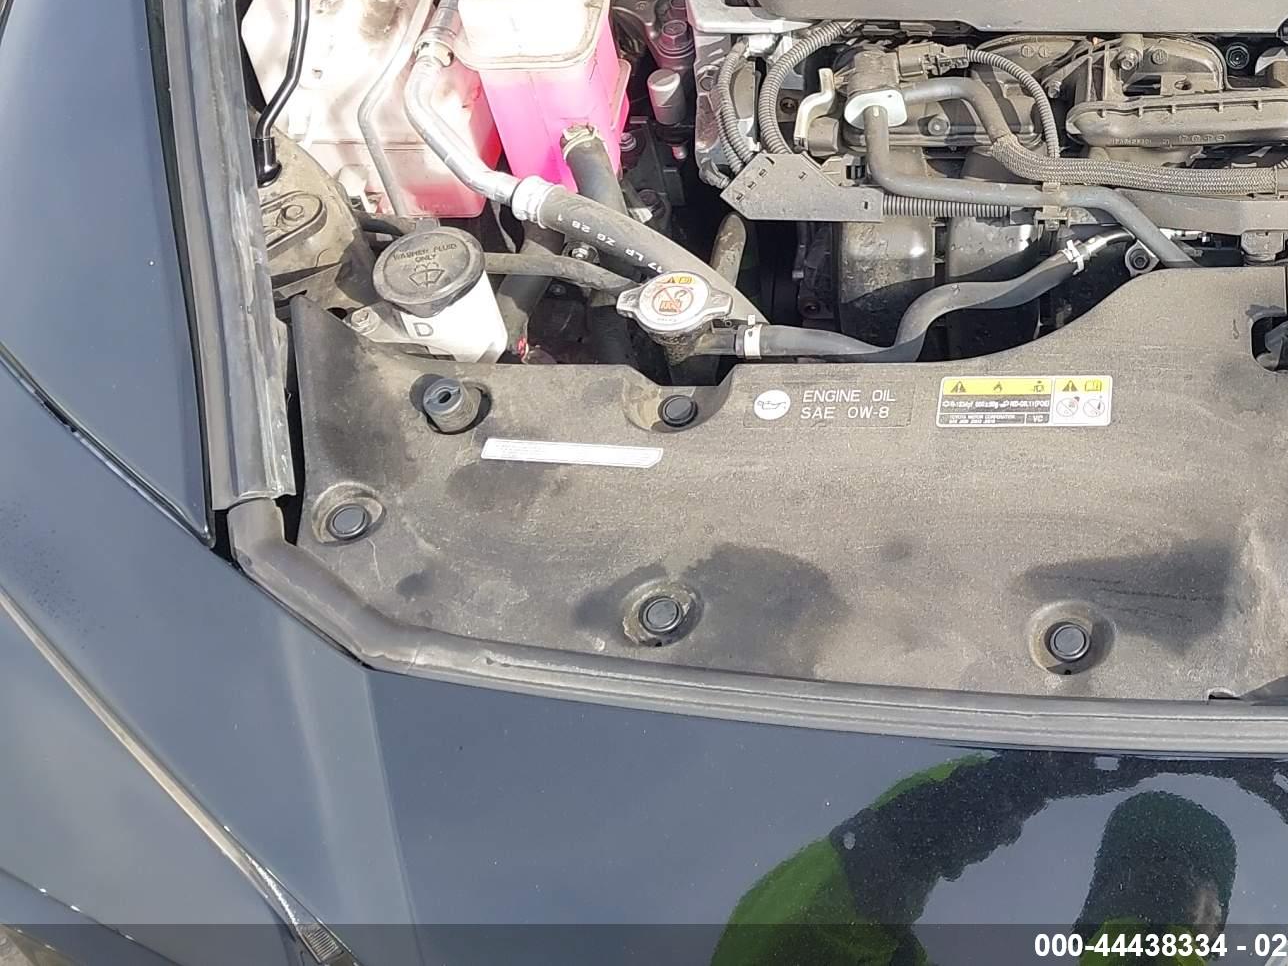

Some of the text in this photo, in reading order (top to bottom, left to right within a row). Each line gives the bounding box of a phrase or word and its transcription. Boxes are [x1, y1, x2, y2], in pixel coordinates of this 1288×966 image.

[433, 243, 457, 253] FLUID
[414, 254, 436, 263] ONLY
[802, 389, 896, 403] ENGINE OIL
[800, 406, 836, 419] SAE
